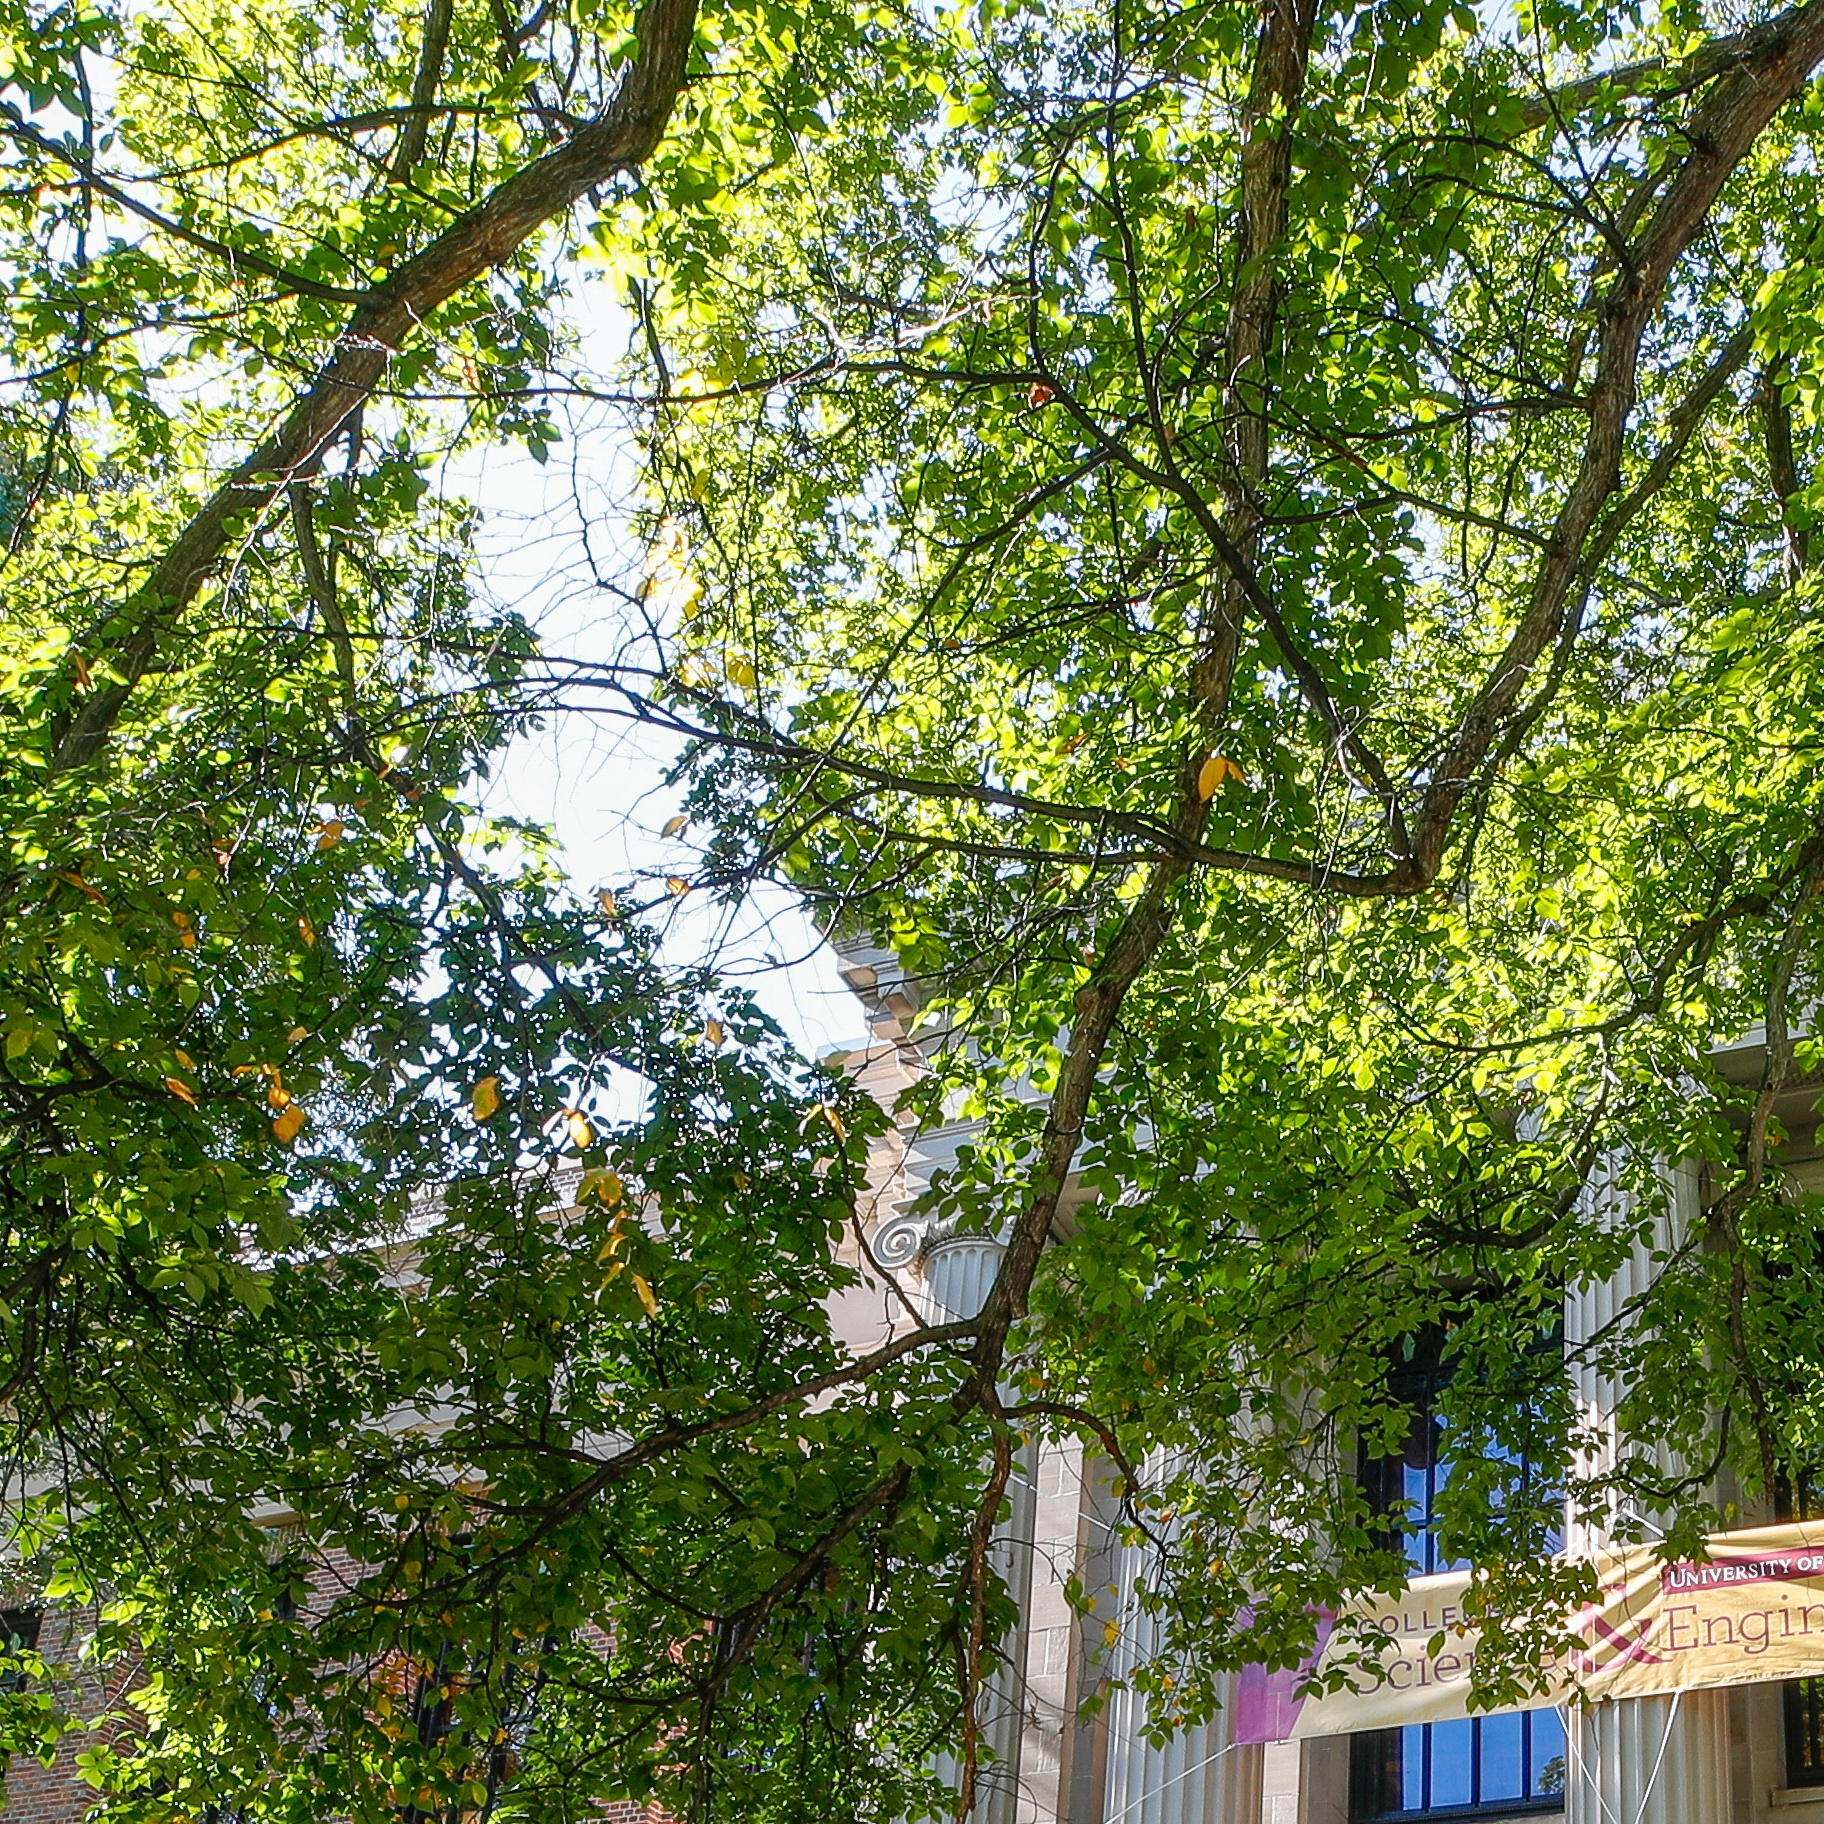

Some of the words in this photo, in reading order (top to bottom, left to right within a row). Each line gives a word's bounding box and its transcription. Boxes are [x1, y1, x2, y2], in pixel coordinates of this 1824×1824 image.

[1669, 1556, 1792, 1589] UNIVERSITY
[1795, 1554, 1824, 1572] OF
[1358, 1600, 1505, 1635] COLLE
[1355, 1645, 1556, 1695] Scie
